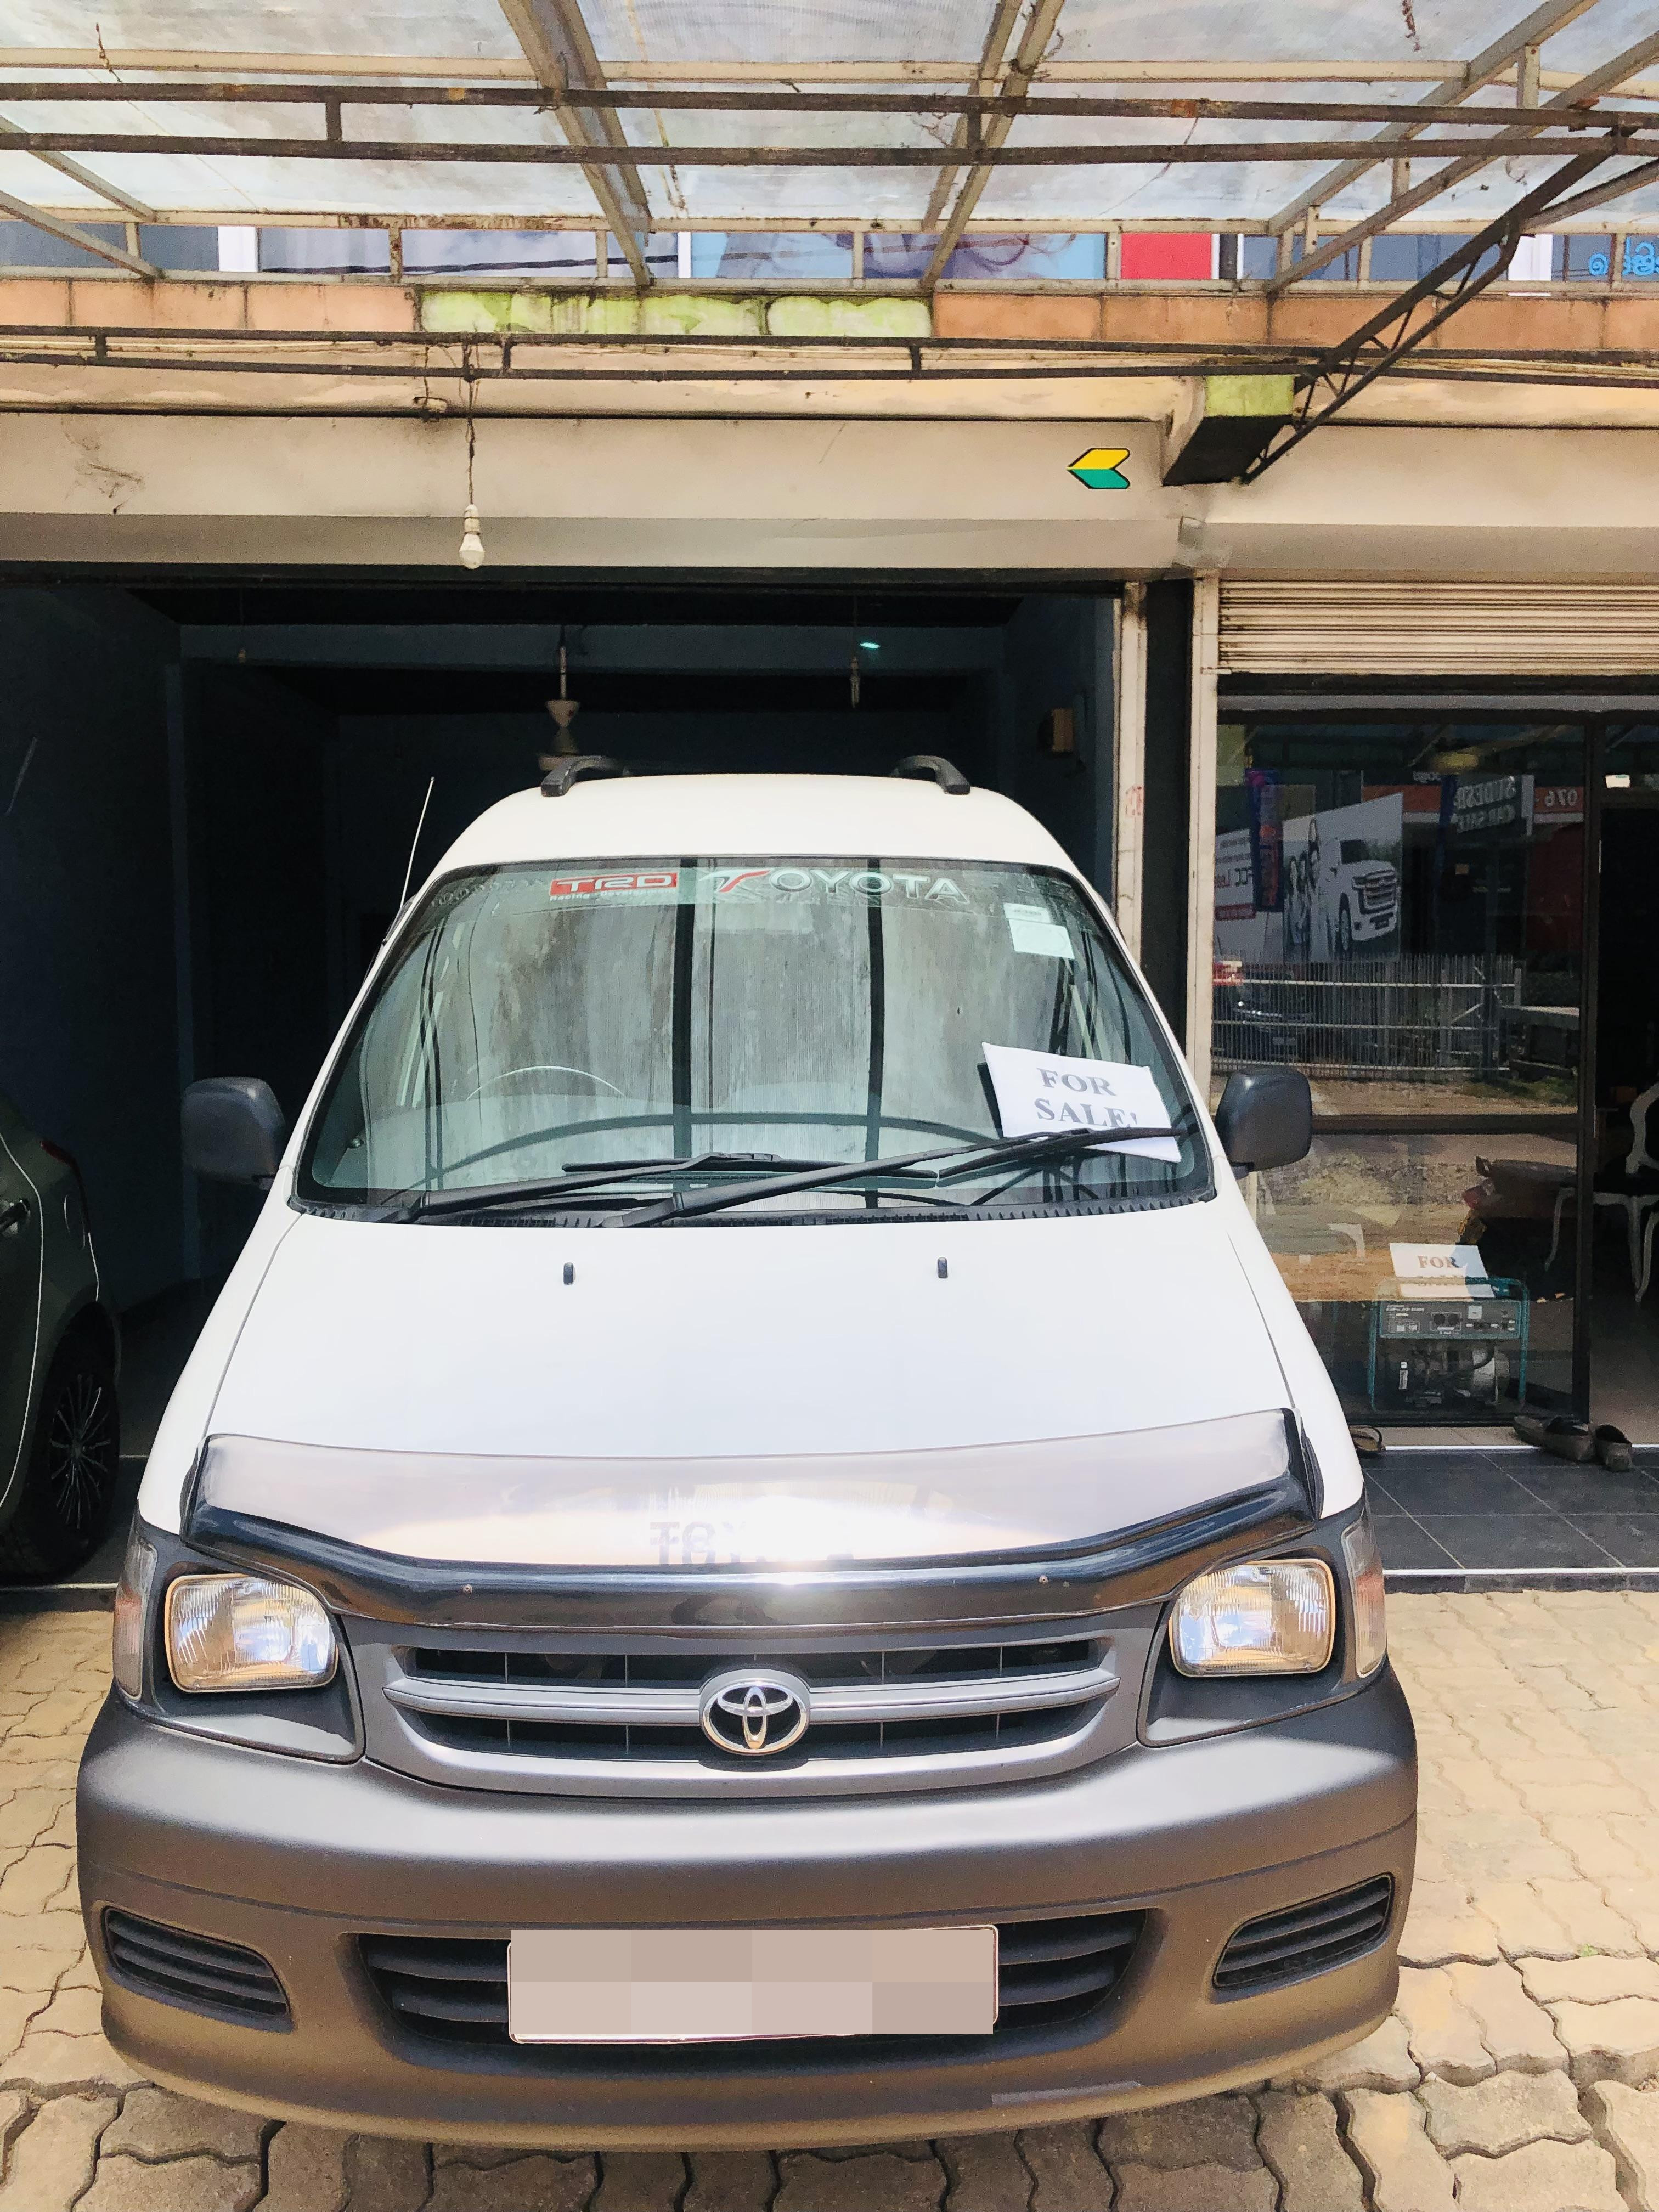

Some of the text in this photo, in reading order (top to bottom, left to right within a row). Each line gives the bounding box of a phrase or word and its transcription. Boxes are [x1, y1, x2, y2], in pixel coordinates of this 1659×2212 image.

[556, 874, 673, 893] TRD
[698, 868, 969, 904] TOYOTA
[1037, 1068, 1117, 1096] FOR
[1418, 1256, 1460, 1268] FOR
